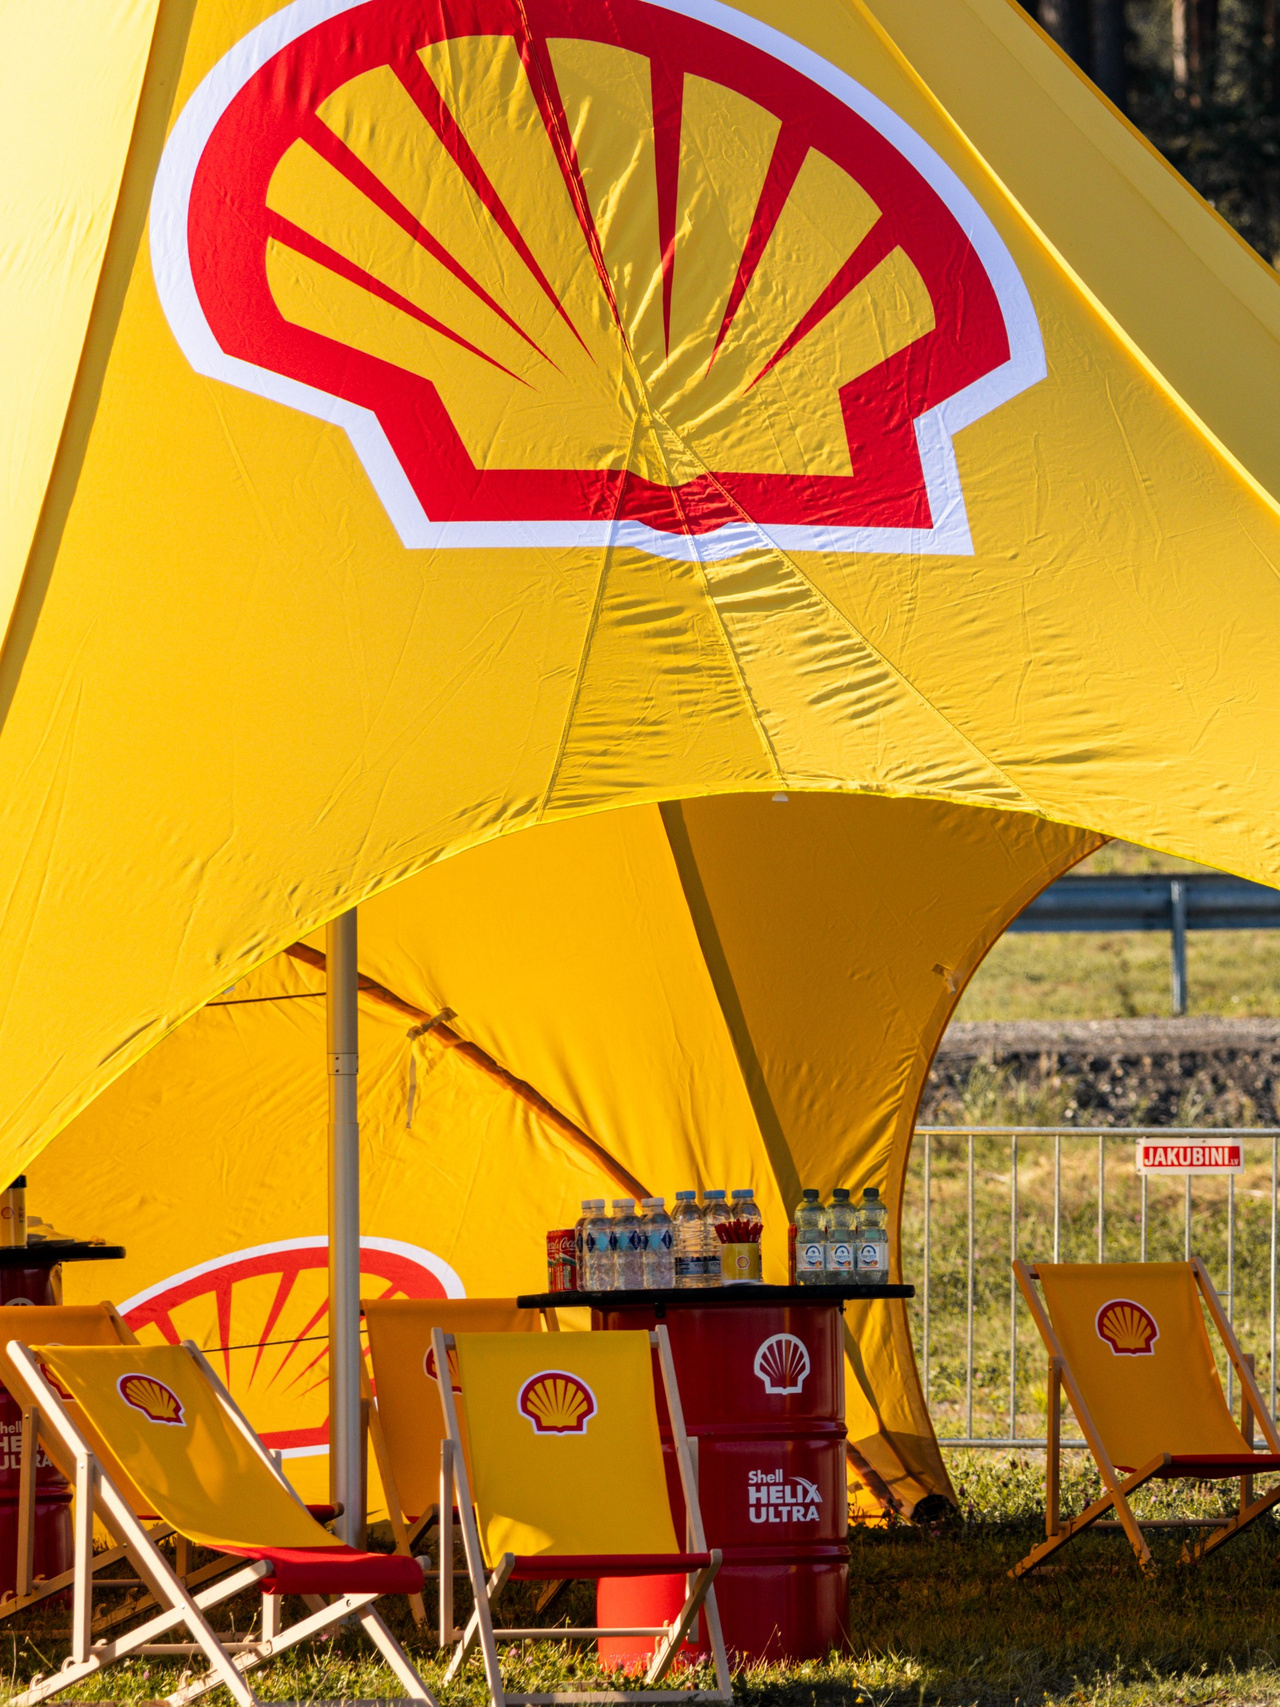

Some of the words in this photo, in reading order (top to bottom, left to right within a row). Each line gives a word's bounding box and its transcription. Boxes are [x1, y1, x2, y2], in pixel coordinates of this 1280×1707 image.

[0, 1420, 22, 1434] hell
[0, 1453, 53, 1470] ULRA
[748, 1468, 783, 1484] Shell
[748, 1482, 823, 1504] HELIX
[749, 1505, 820, 1523] ULTRA
